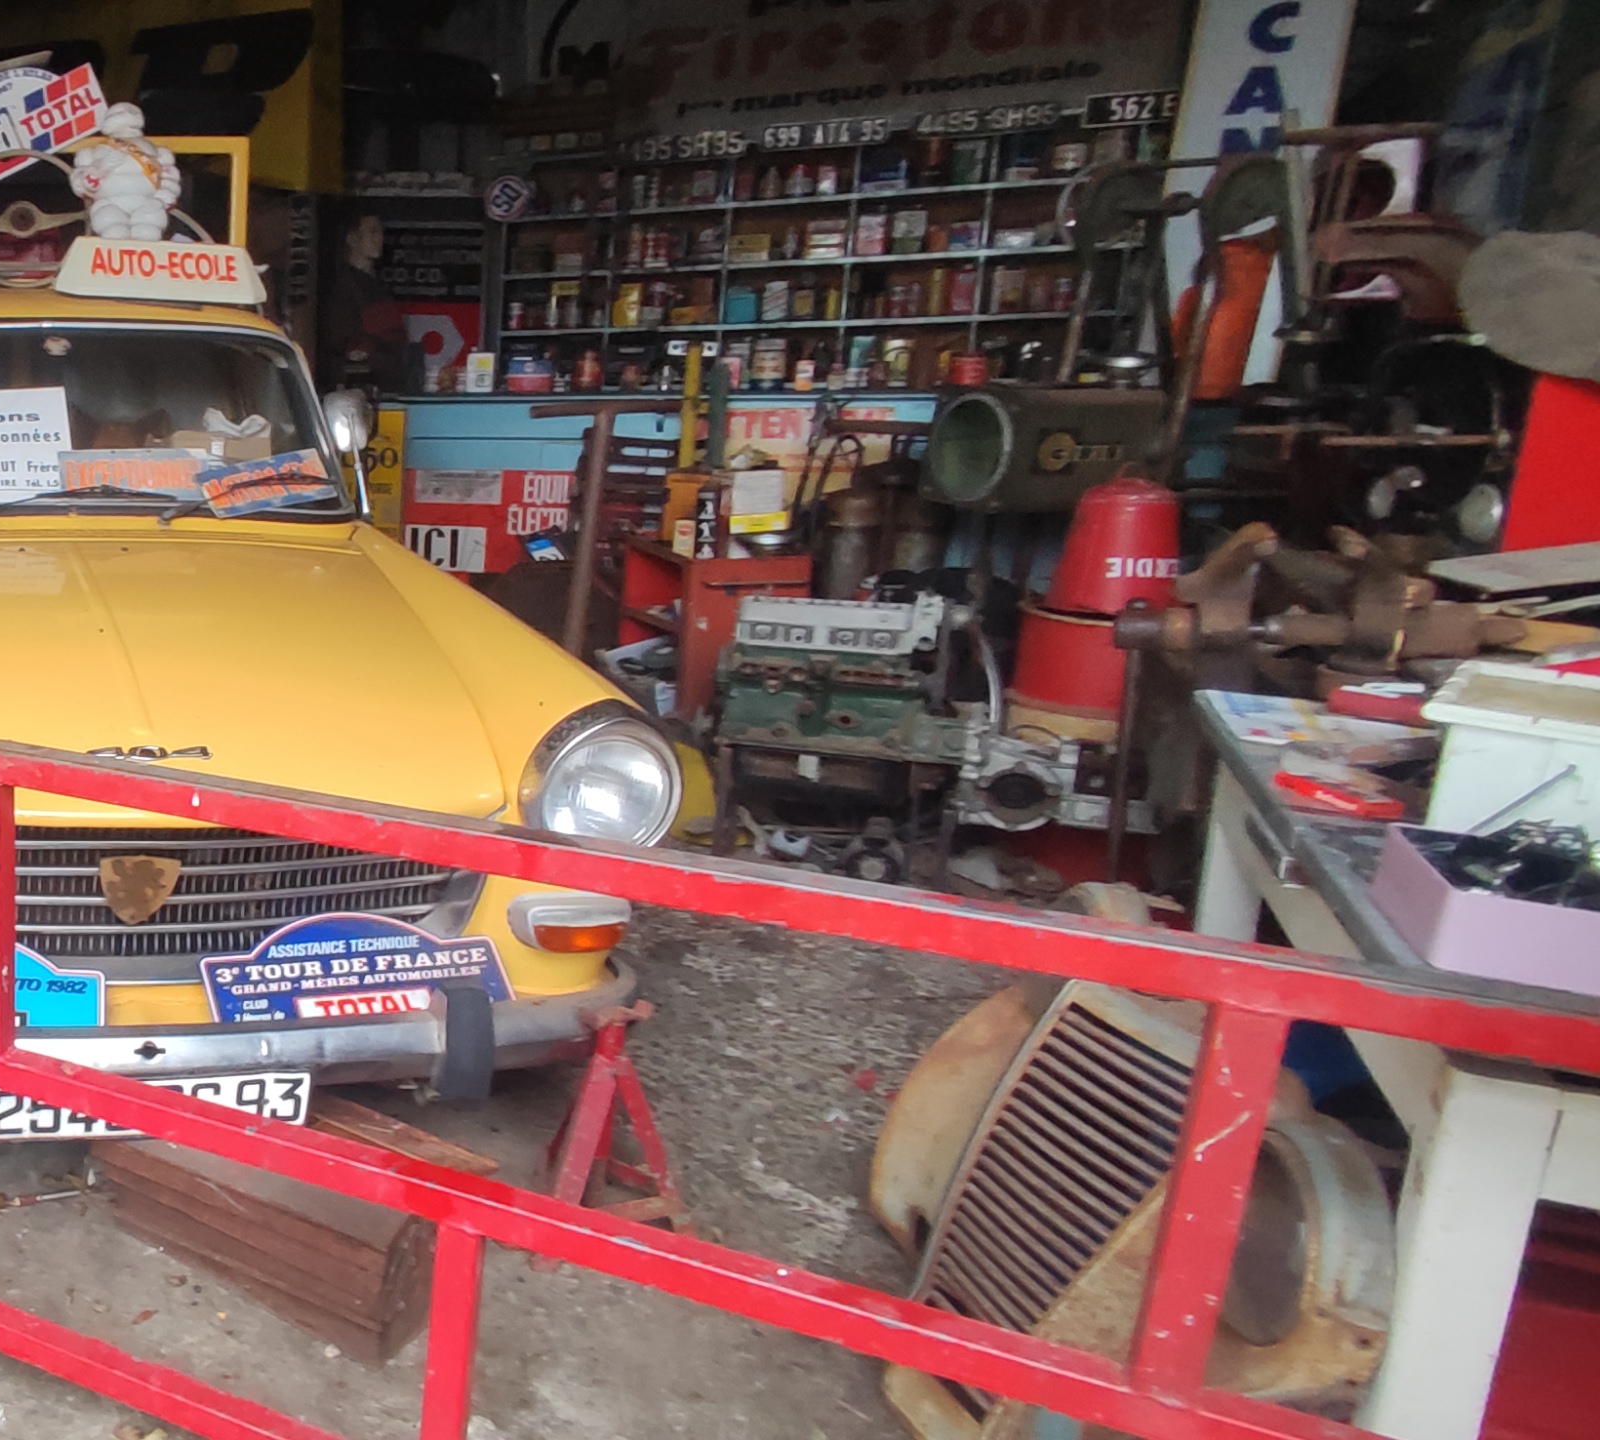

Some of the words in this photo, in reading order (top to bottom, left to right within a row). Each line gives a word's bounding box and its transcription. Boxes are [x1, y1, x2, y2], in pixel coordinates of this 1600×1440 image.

[732, 82, 888, 112] marque
[900, 60, 1100, 95] mondiale
[19, 87, 101, 137] TOTAL
[1109, 95, 1154, 121] 562
[90, 247, 238, 283] AUTO-ECOLE
[267, 939, 347, 959] ASSISTANCE
[349, 934, 421, 953] TECHNIQUE
[245, 959, 324, 981] TOUR
[330, 956, 369, 974] DE
[373, 947, 489, 971] FRANCE
[46, 980, 89, 995] 1982
[242, 998, 269, 1011] CLUB
[314, 993, 425, 1017] TOTAL
[234, 1077, 305, 1122] 93
